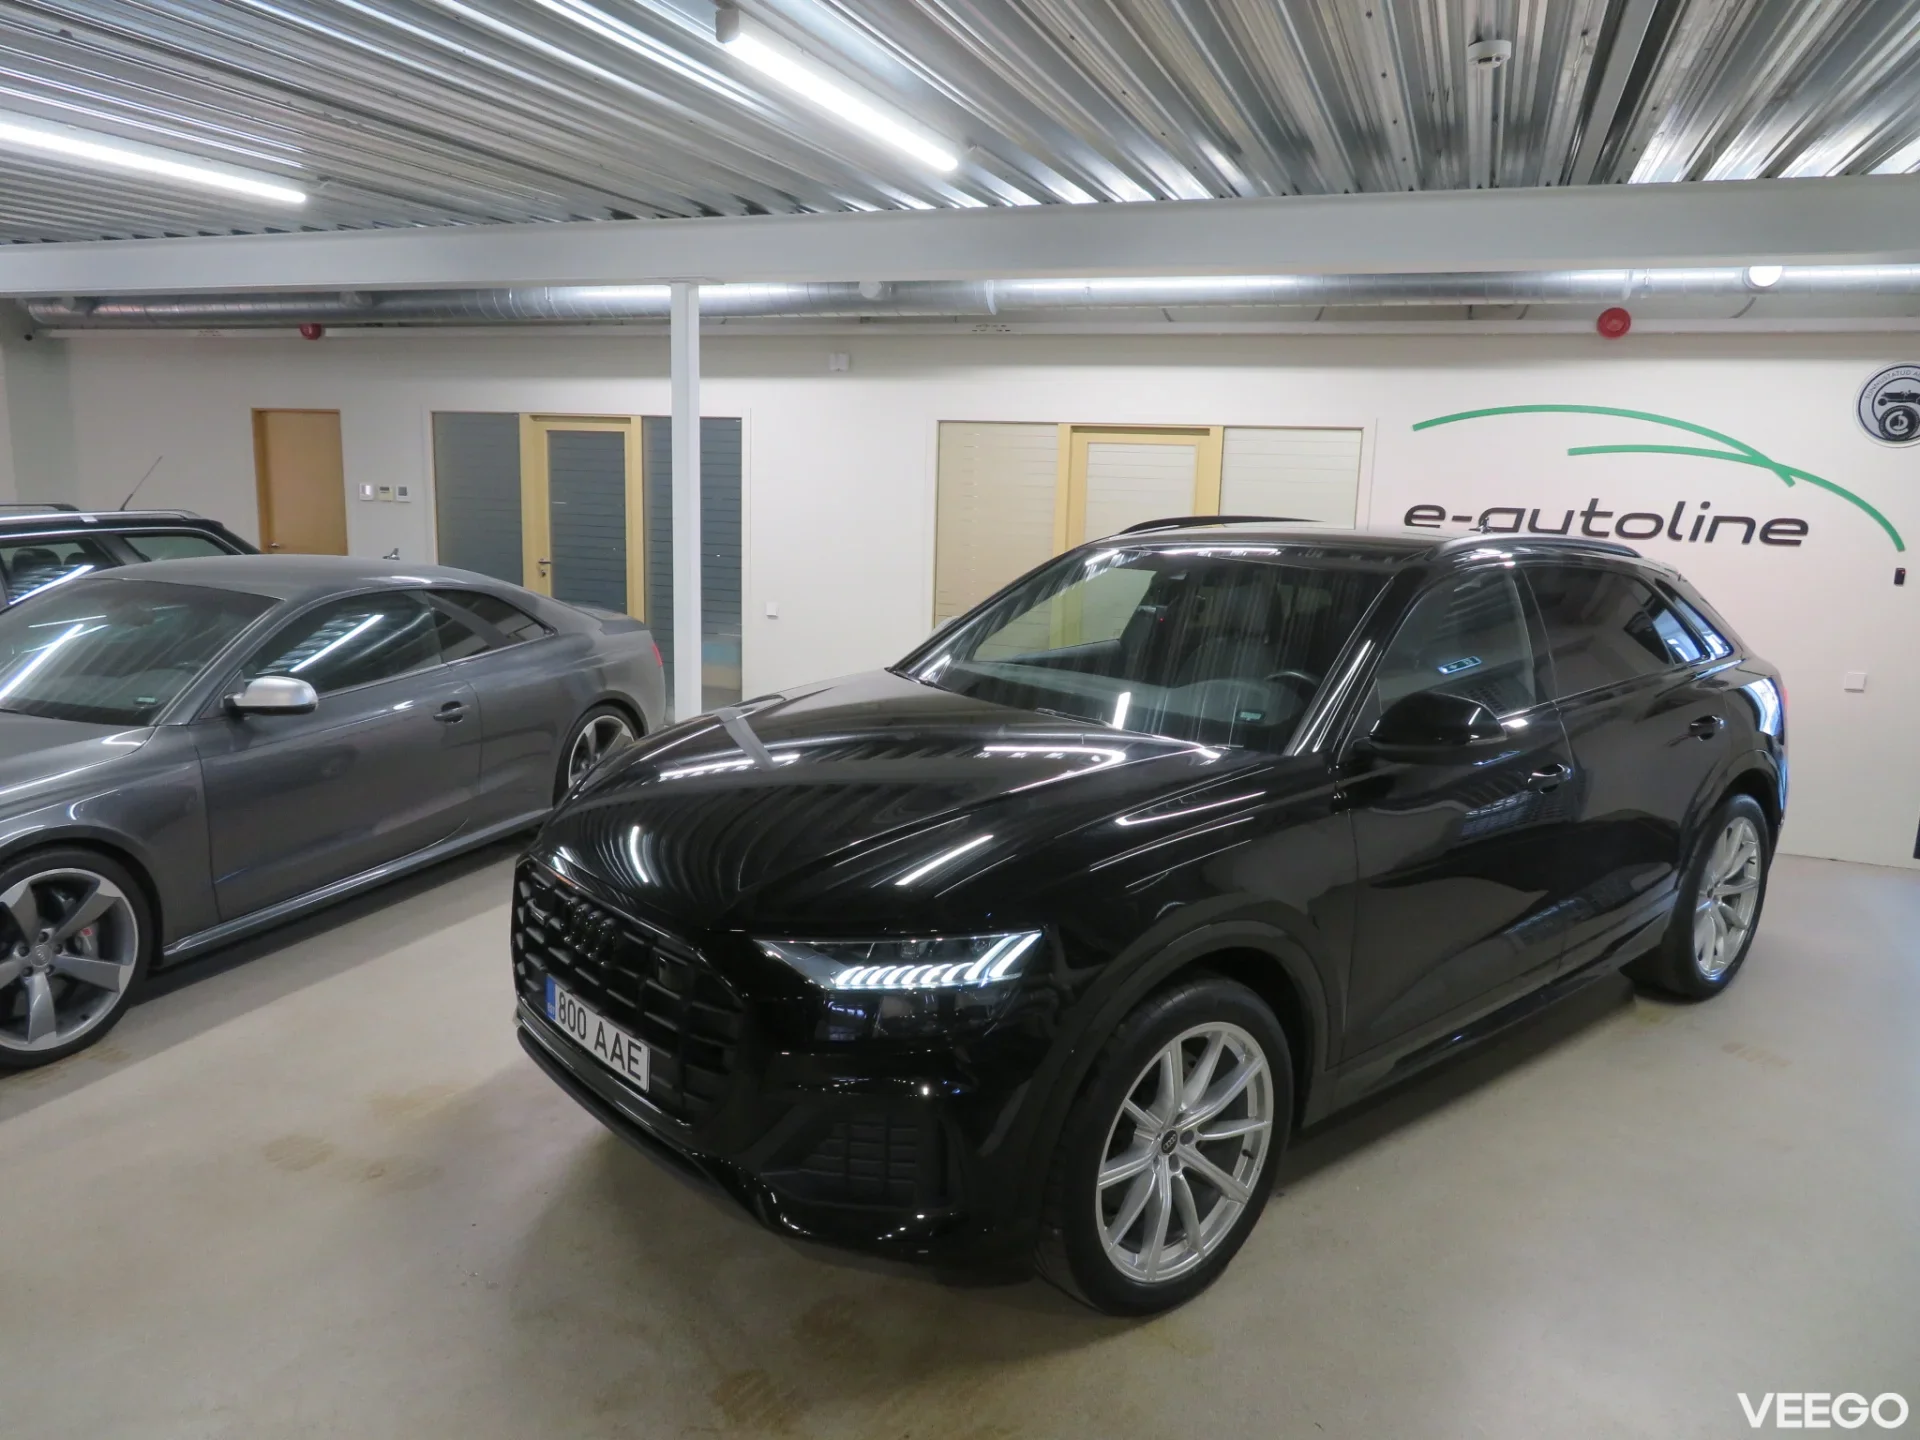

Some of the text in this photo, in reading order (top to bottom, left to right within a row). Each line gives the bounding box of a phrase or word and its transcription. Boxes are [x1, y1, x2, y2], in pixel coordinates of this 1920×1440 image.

[1404, 498, 1809, 547] e-autoline
[559, 991, 642, 1081] 800 AAE
